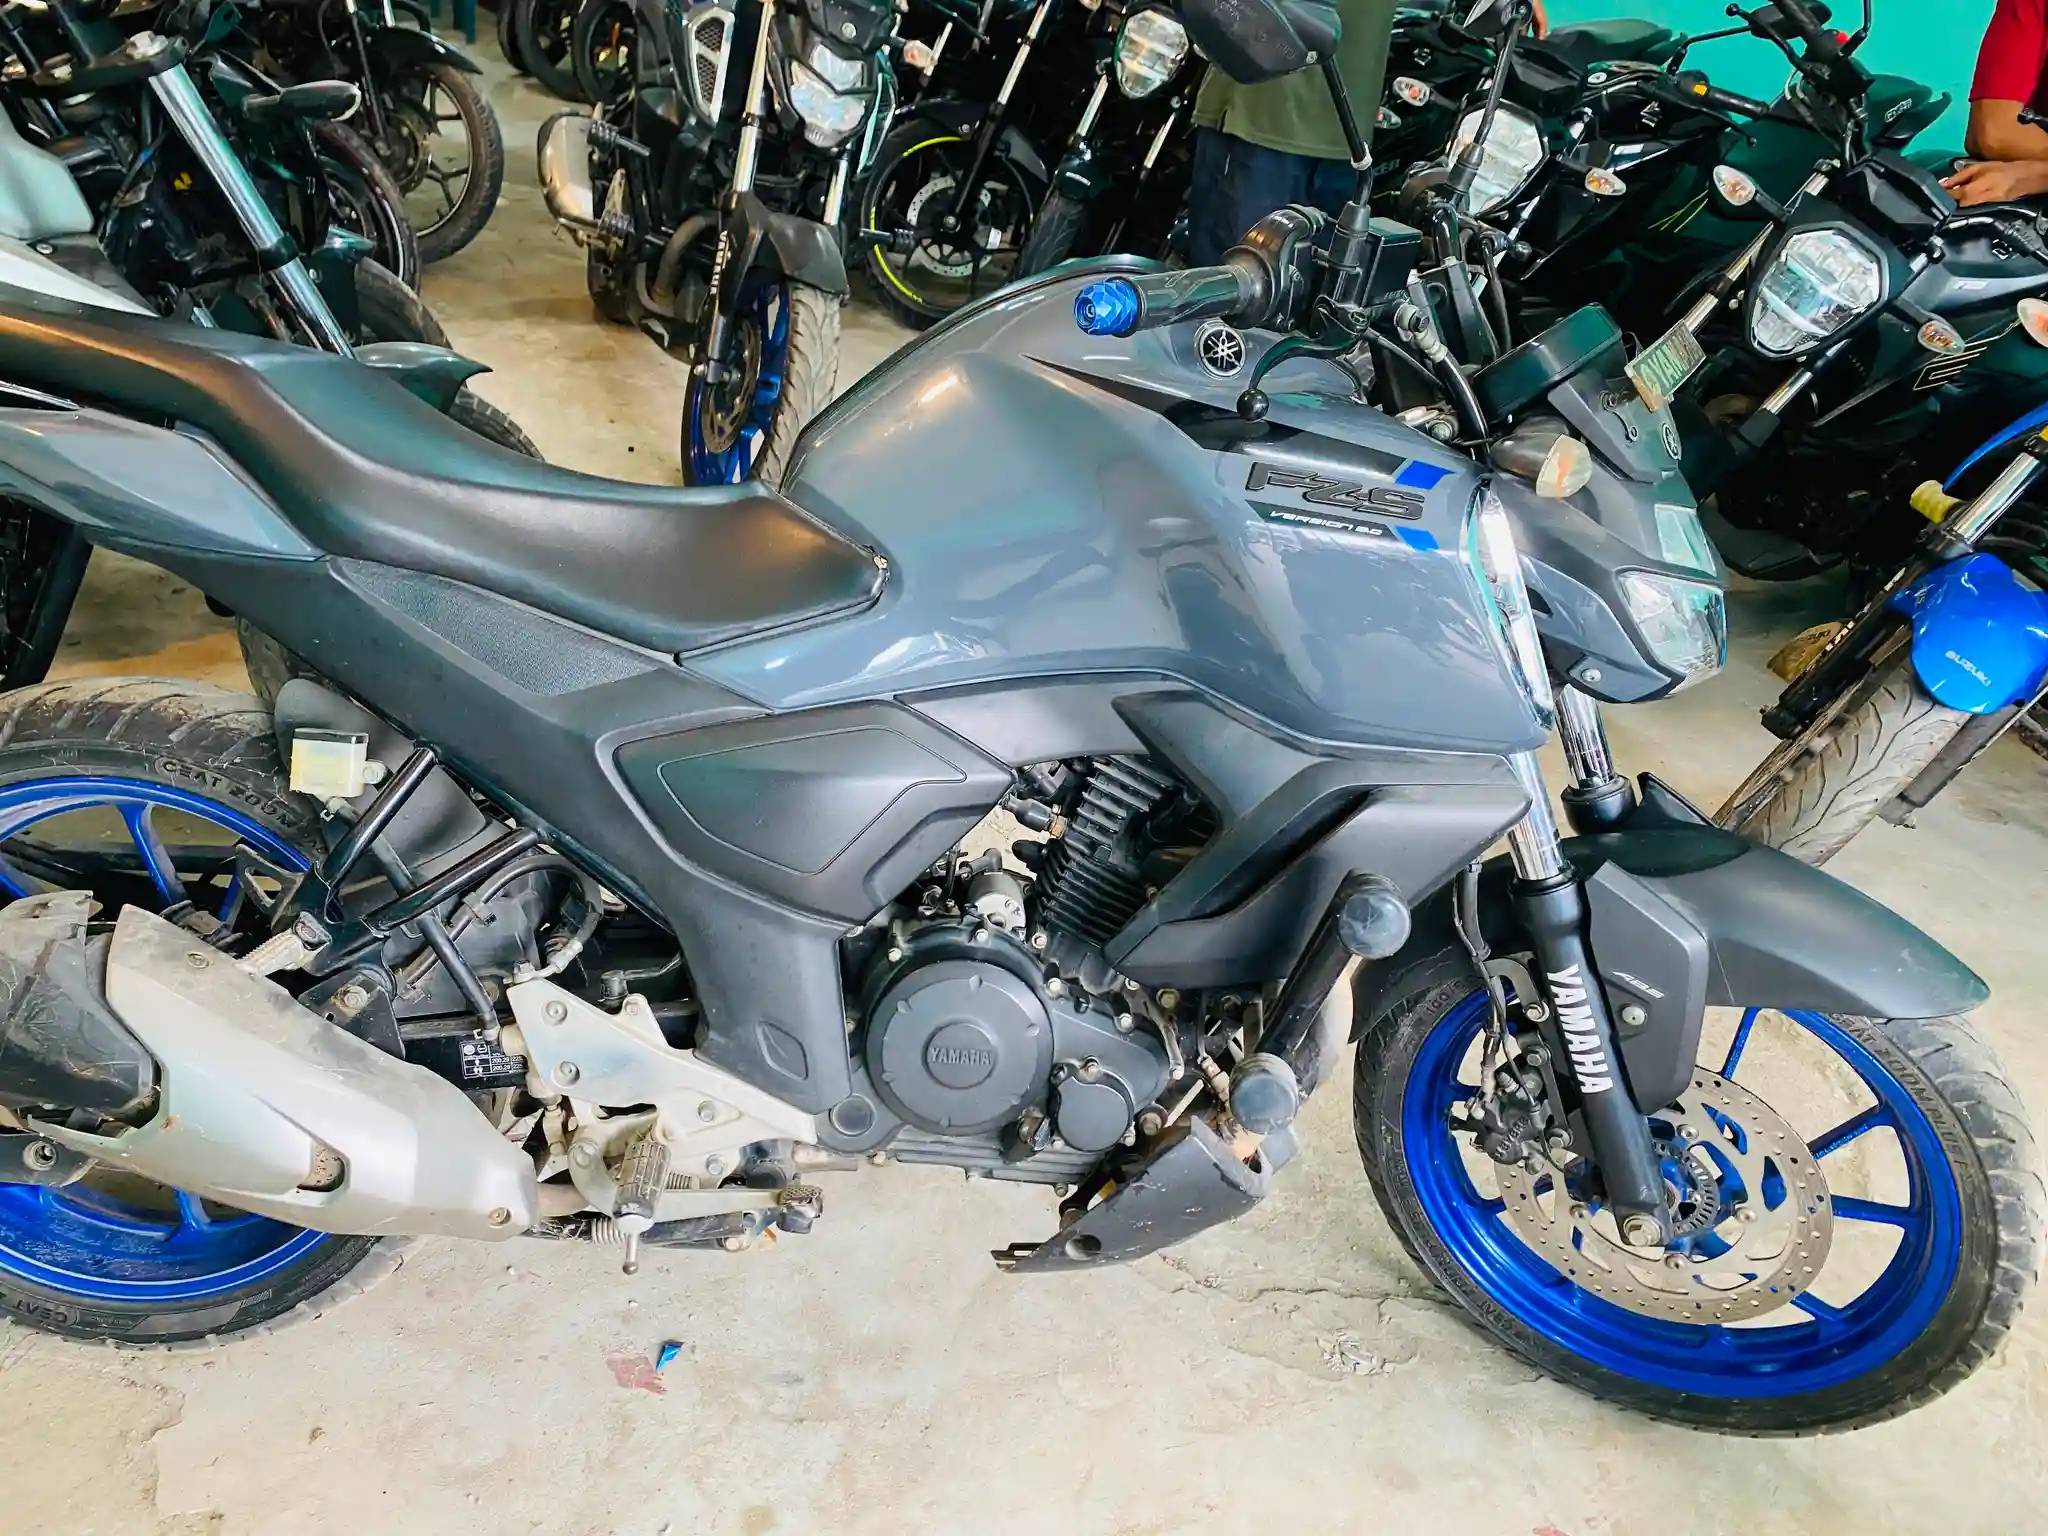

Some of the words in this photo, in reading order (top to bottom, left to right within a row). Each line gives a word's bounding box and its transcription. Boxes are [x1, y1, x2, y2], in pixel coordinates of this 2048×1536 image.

[1945, 650, 1992, 688] SUZUKI
[161, 760, 222, 788] CEAT
[1546, 963, 1614, 1094] YAMAHA
[931, 1046, 993, 1066] YAMAHA
